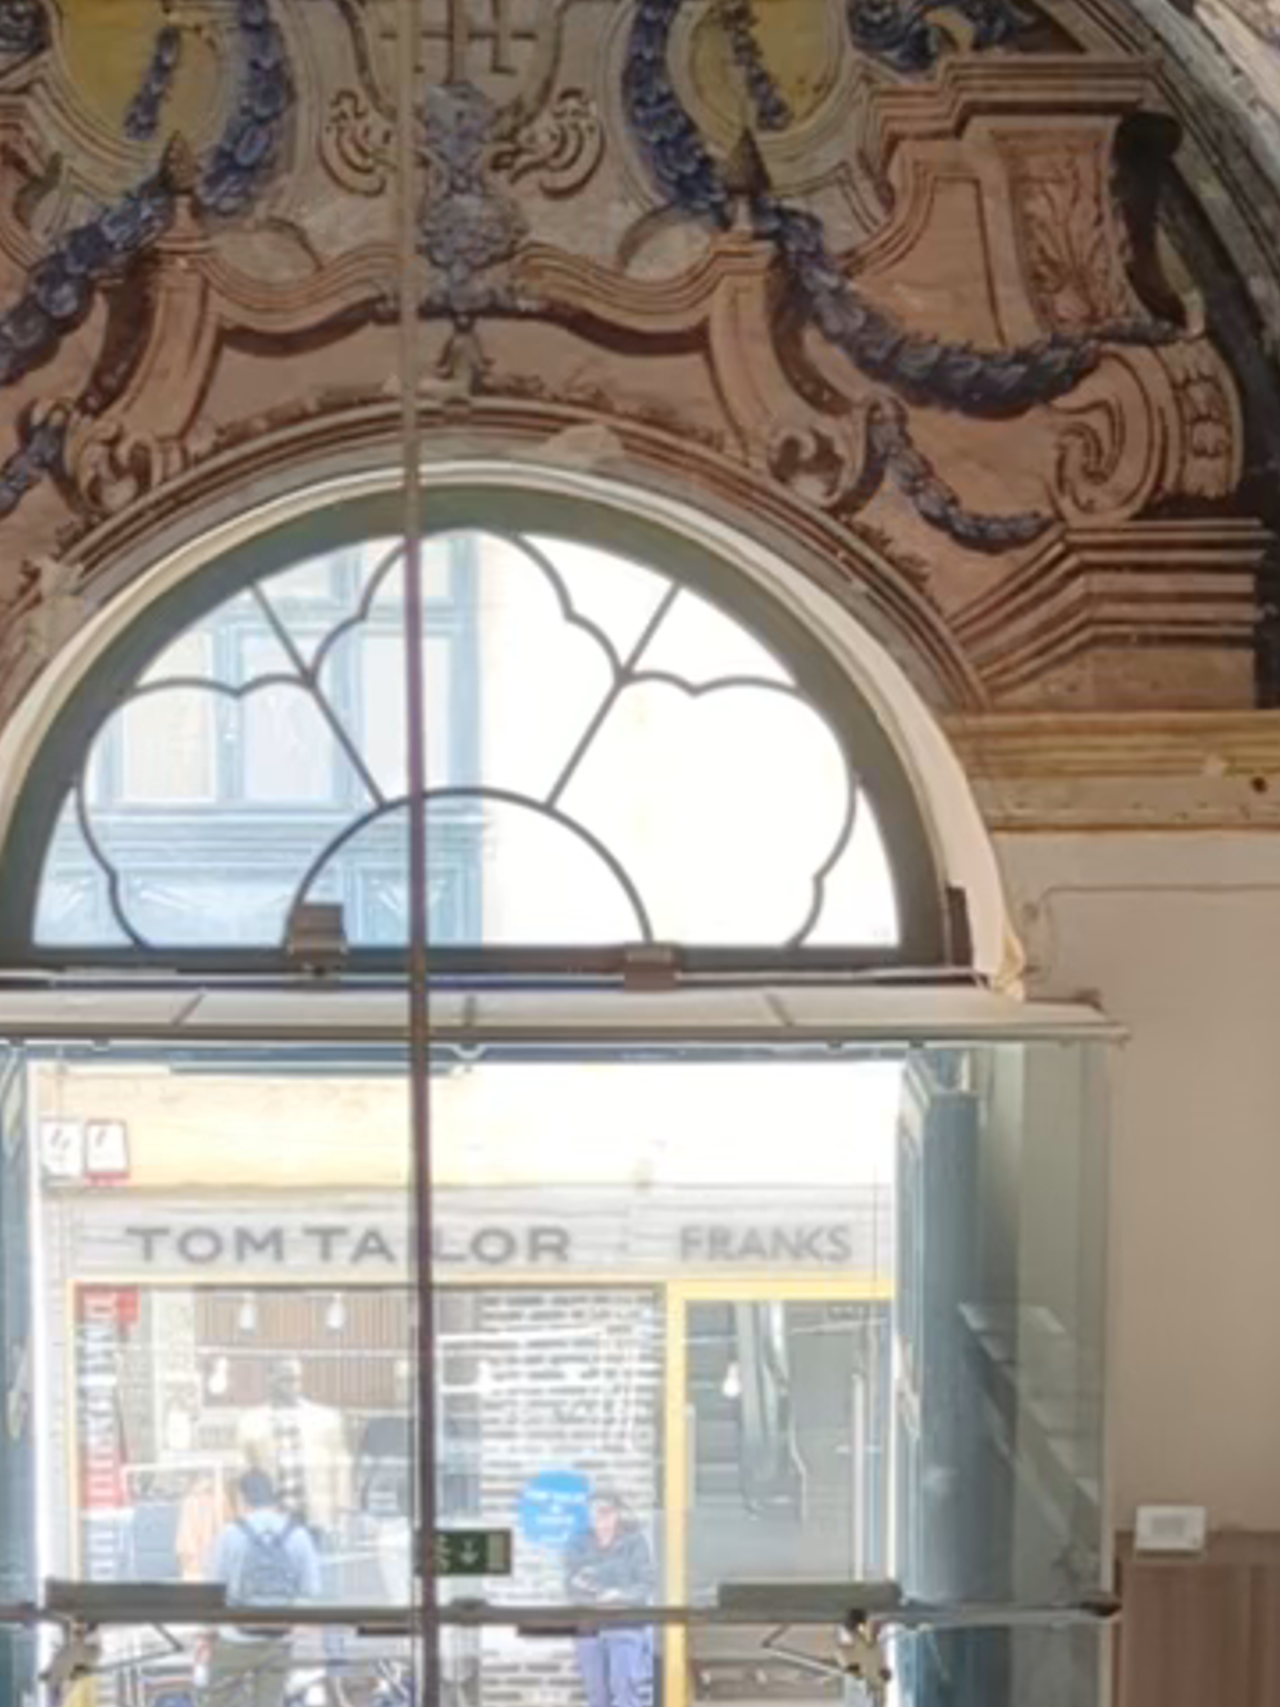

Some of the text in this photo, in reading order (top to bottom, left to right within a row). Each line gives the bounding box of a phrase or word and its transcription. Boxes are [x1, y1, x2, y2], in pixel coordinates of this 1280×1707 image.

[124, 1225, 570, 1265] TOM TALOR
[679, 1224, 854, 1263] FRANKS
